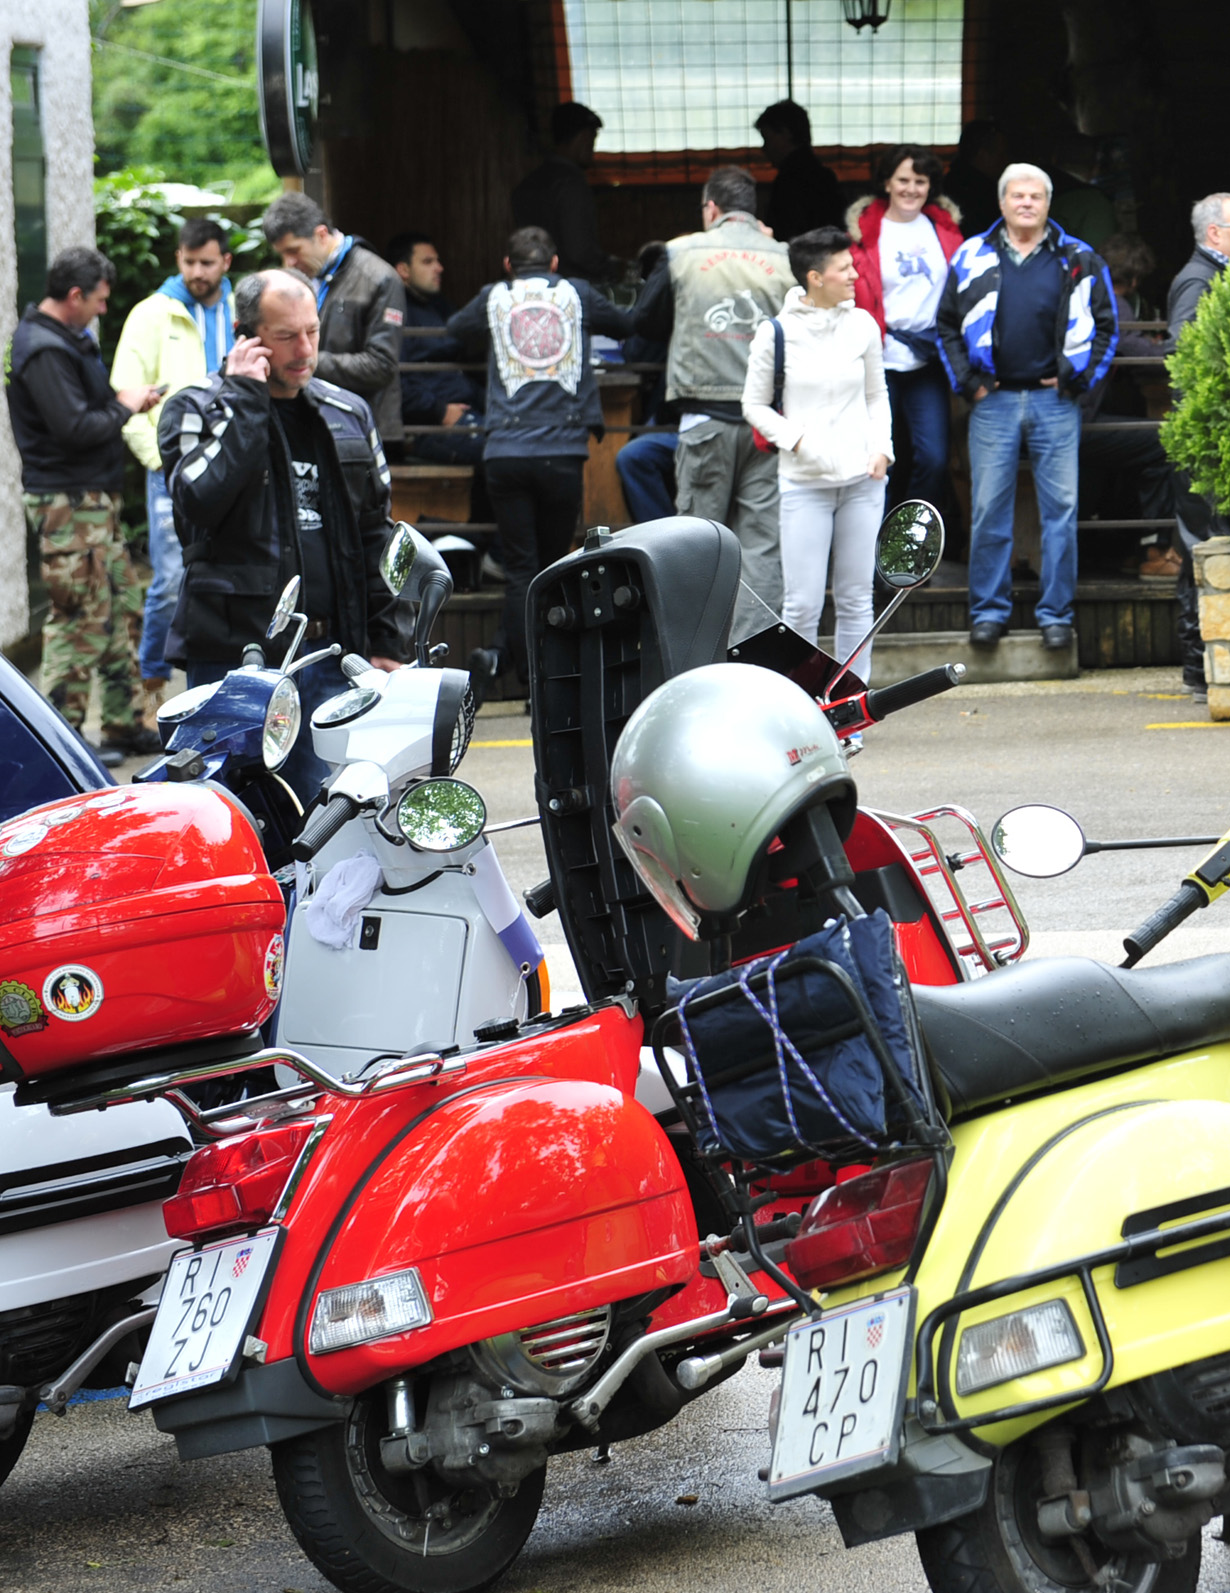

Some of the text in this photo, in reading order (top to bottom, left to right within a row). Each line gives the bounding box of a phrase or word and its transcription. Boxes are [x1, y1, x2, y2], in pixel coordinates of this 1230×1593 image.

[180, 1250, 223, 1298] RI
[172, 1286, 232, 1339] 760
[163, 1330, 213, 1379] ZJ
[807, 1317, 849, 1375] RI
[802, 1358, 879, 1420] 470
[808, 1412, 858, 1466] CP
